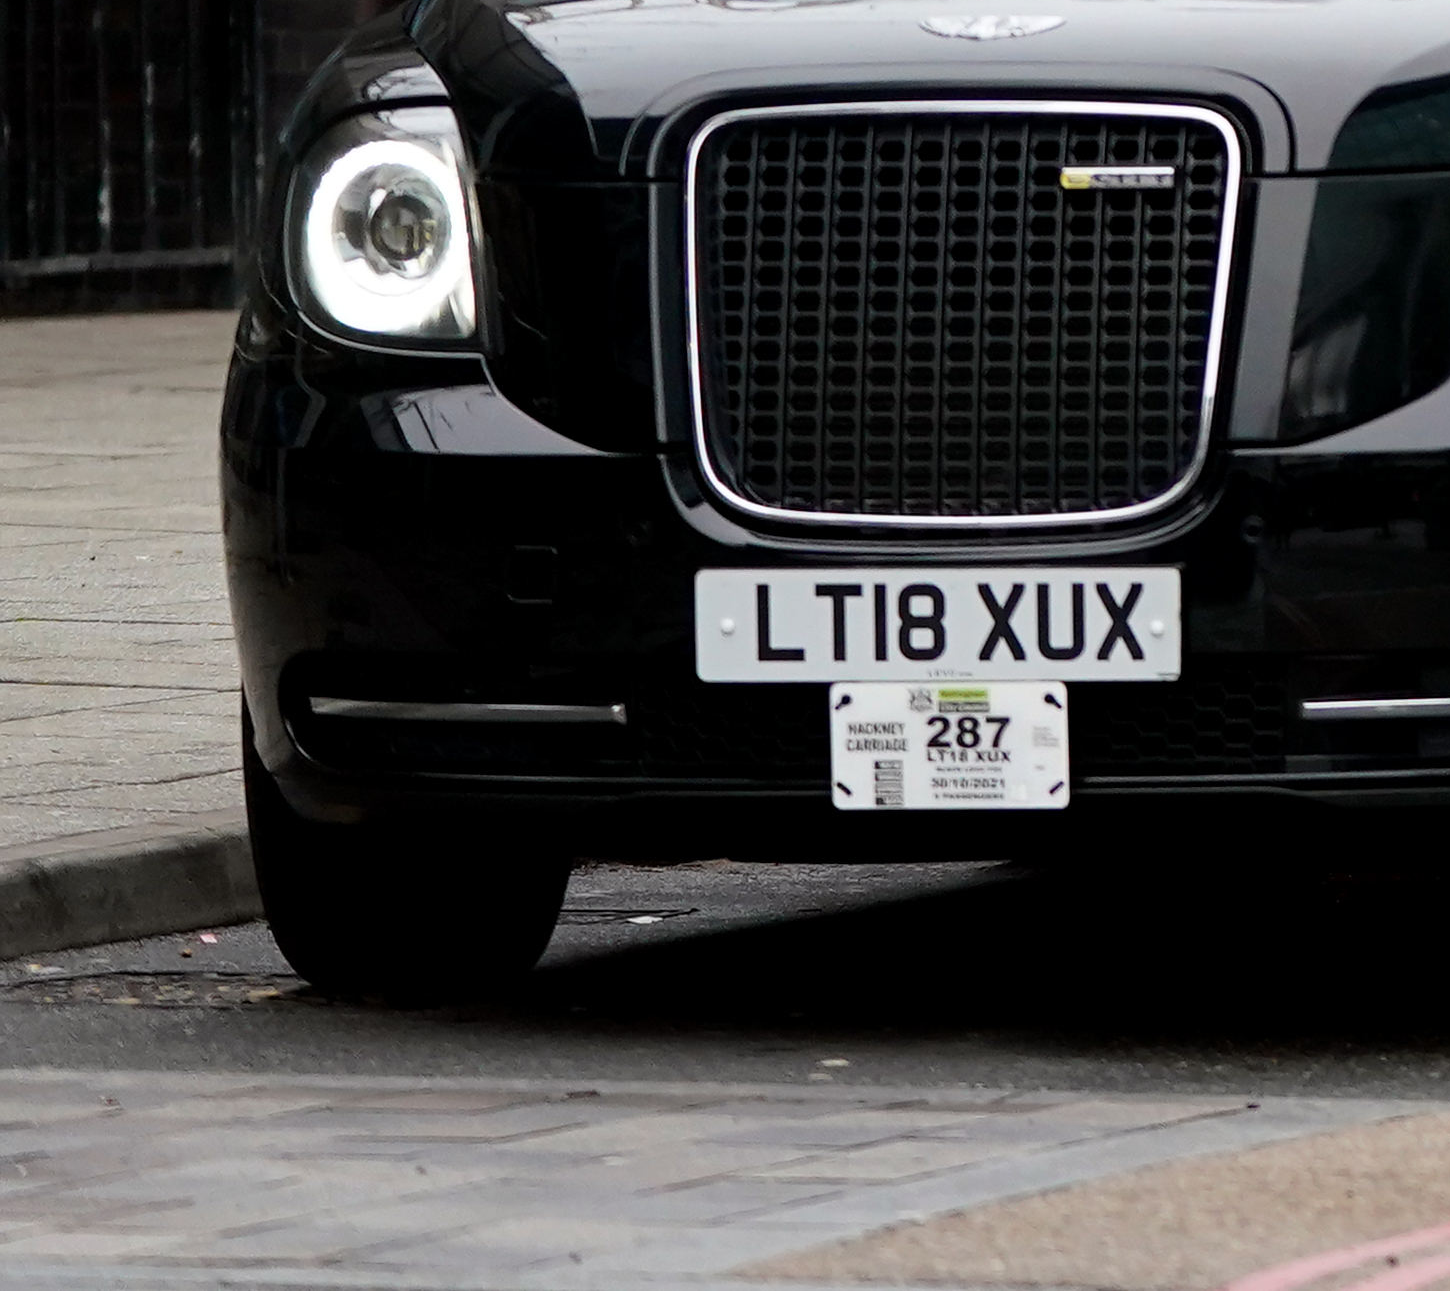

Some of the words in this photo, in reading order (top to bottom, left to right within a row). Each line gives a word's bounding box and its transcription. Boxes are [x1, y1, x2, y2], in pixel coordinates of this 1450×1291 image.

[756, 583, 946, 662] LT18
[978, 583, 1145, 662] XUX
[926, 716, 1011, 749] 287
